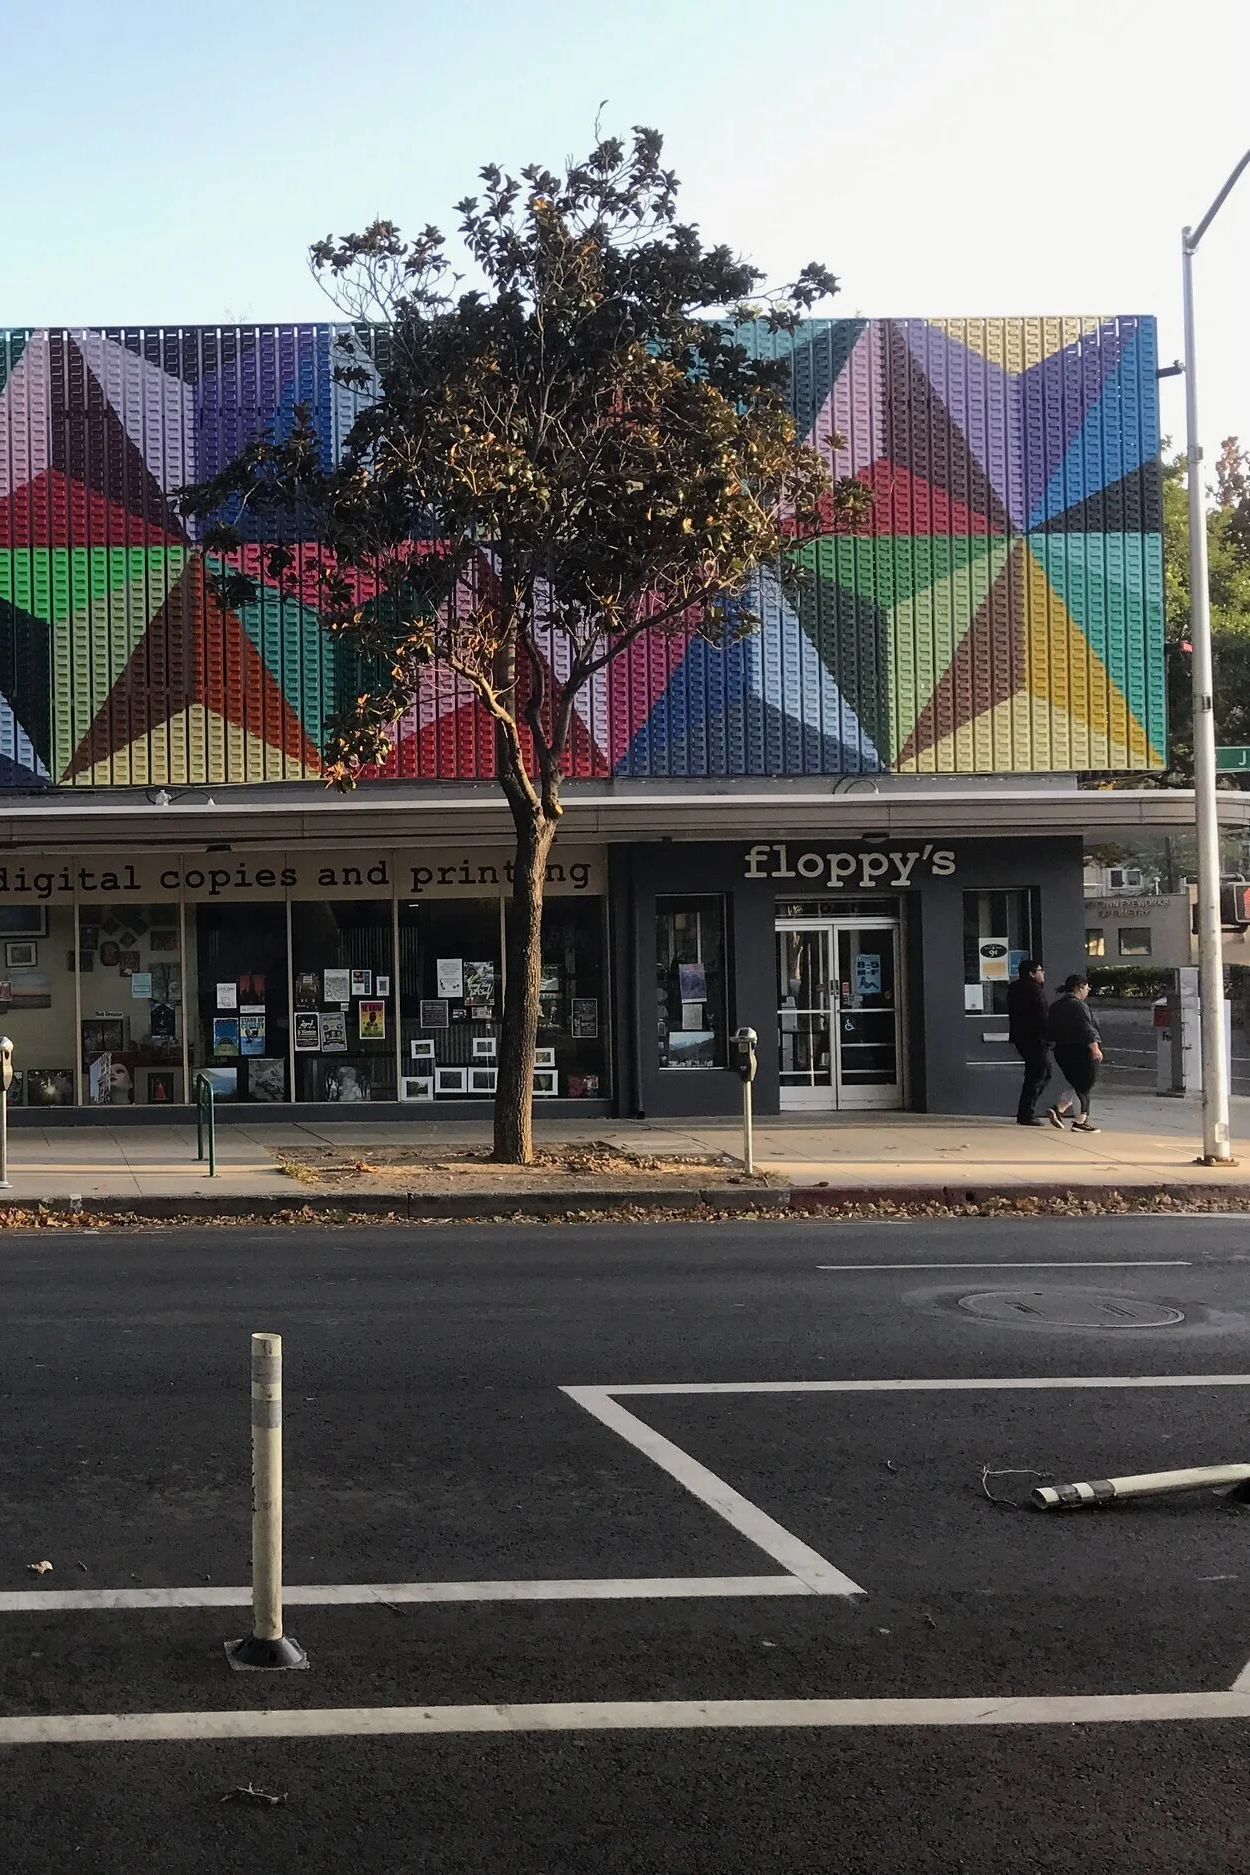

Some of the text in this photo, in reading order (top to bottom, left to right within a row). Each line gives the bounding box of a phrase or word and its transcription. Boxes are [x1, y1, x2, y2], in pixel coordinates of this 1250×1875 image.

[1238, 750, 1247, 766] J
[160, 863, 297, 895] copies
[317, 861, 390, 886] and
[410, 860, 591, 892] printng
[744, 844, 956, 887] floppy's
